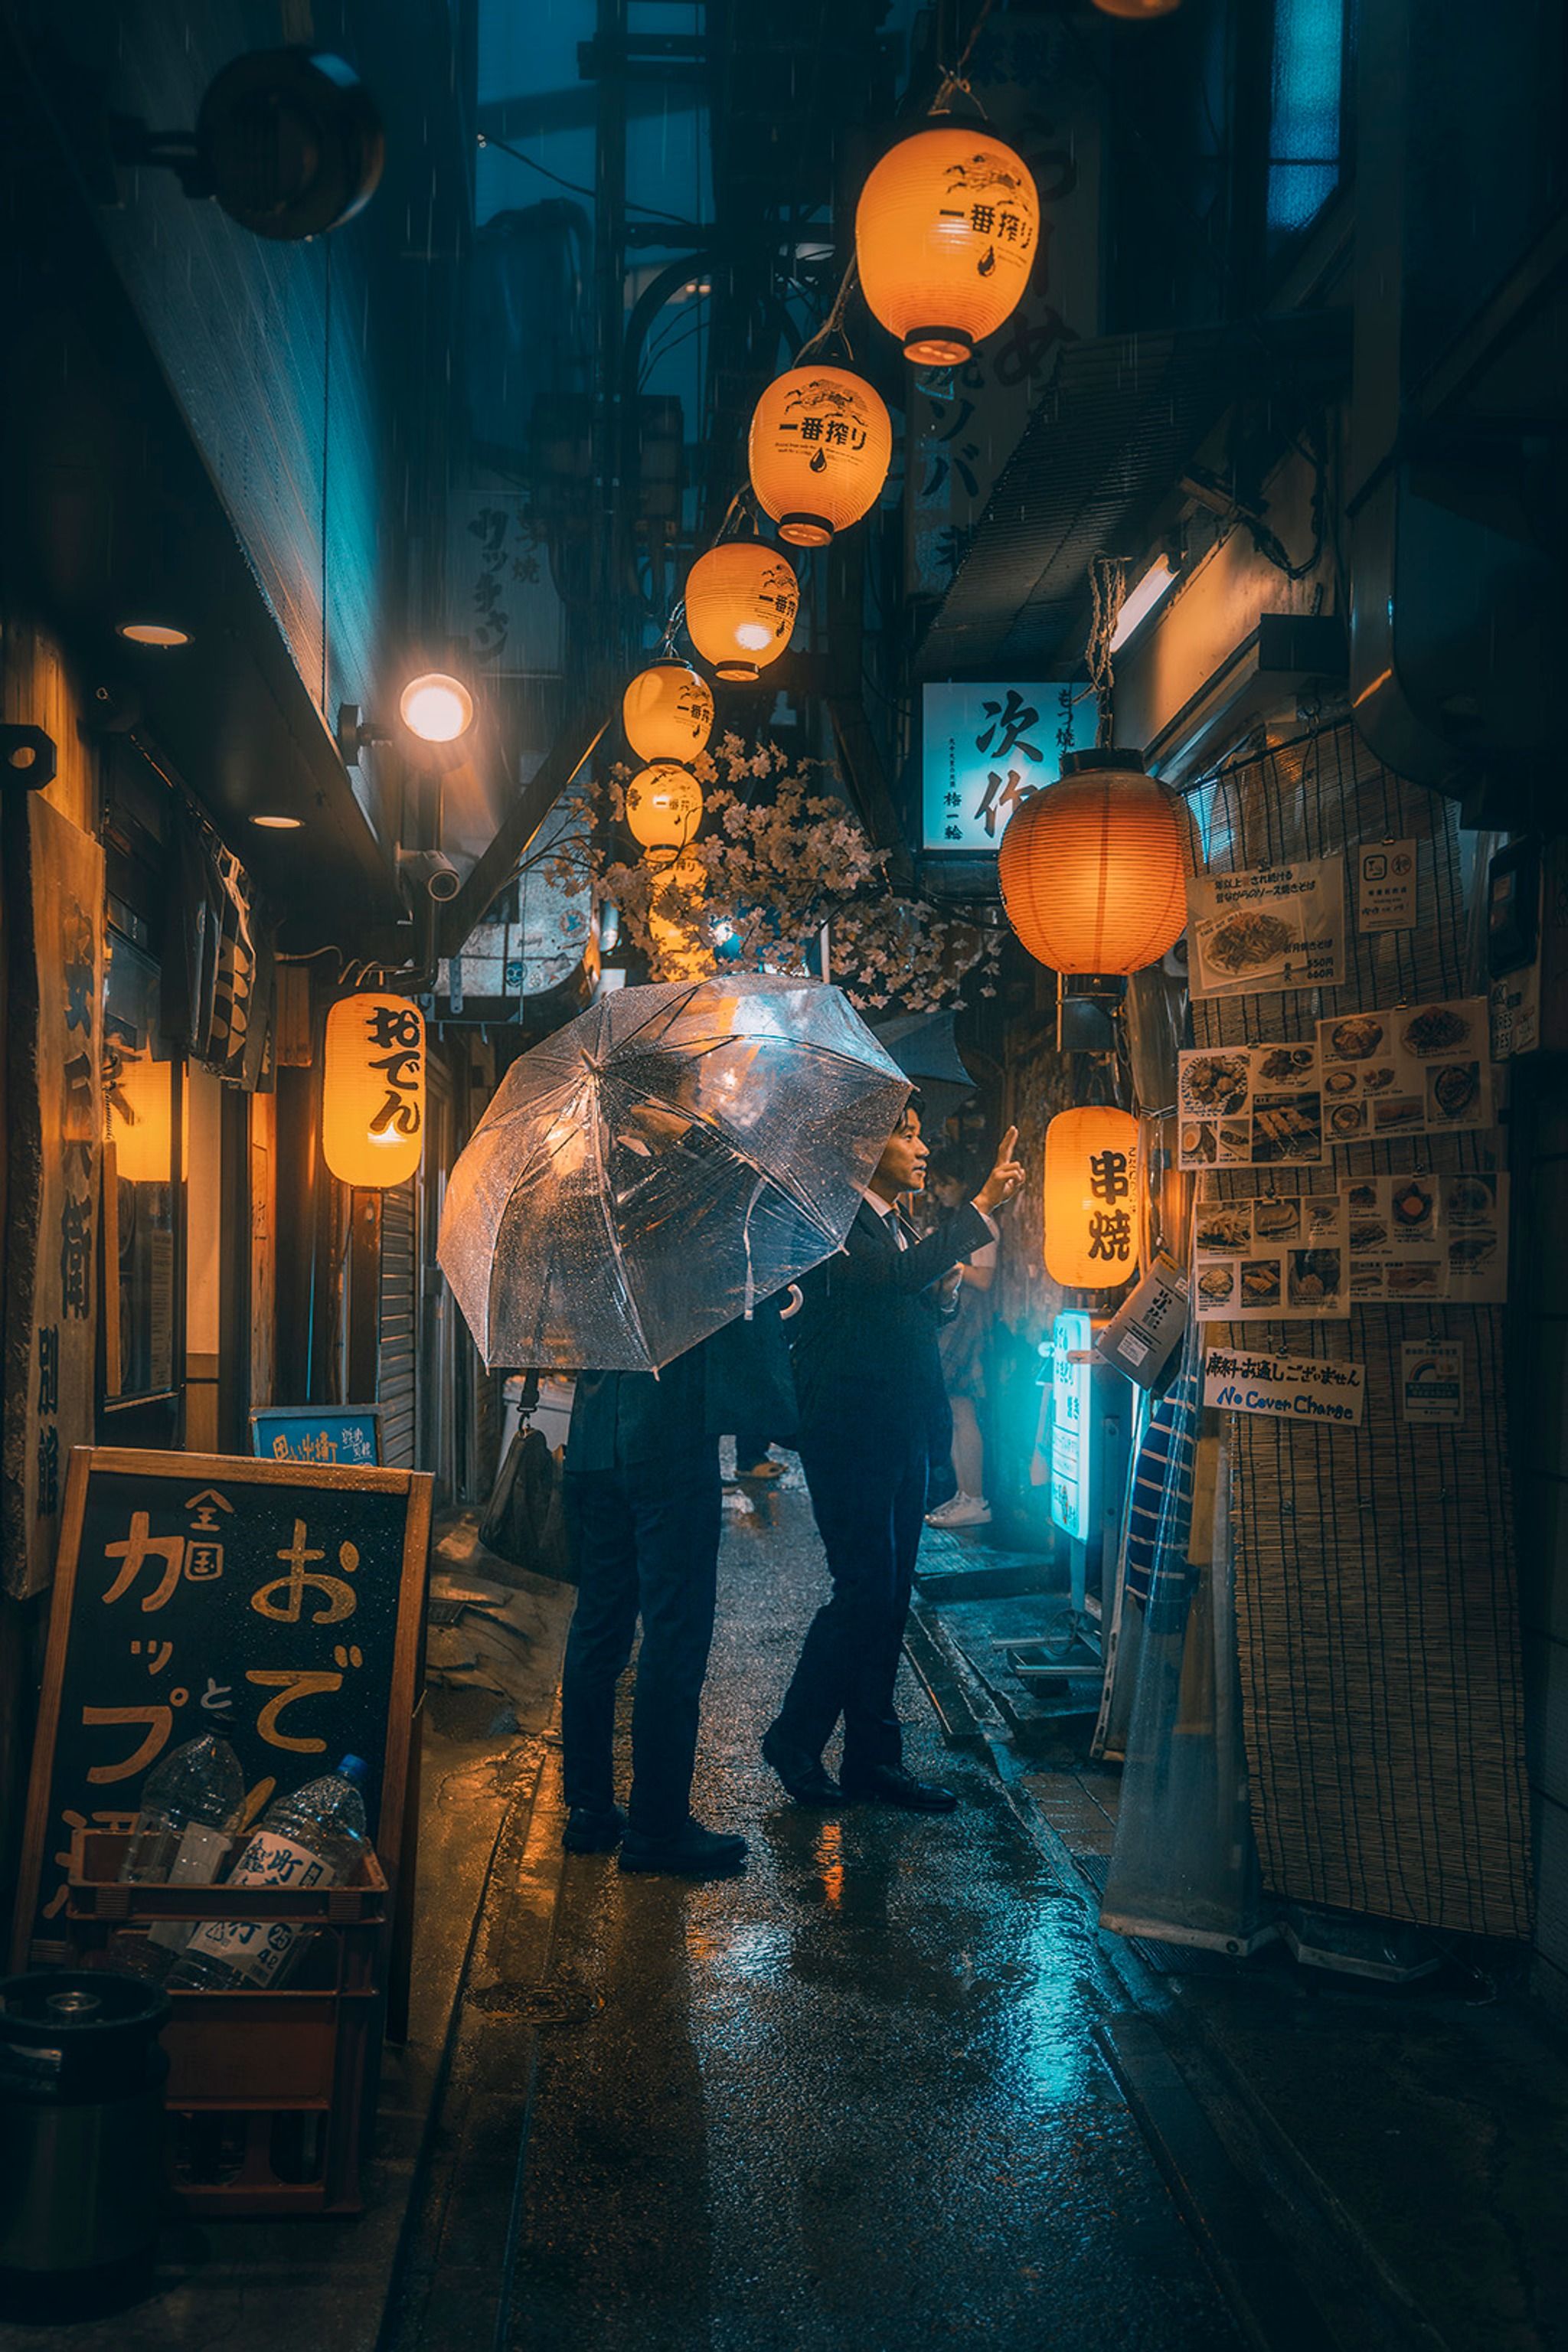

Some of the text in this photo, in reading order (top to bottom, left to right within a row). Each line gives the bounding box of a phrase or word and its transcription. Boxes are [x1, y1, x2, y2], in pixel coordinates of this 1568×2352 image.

[939, 203, 1033, 250] 一番搾り
[779, 417, 867, 450] 一番搾り
[366, 1006, 420, 1134] おでん
[1088, 1150, 1131, 1262] 串焼
[1217, 1386, 1354, 1420] No Cover Charge
[185, 1488, 234, 1581] 全国
[201, 1677, 232, 1709] と
[270, 1925, 291, 1949] 25
